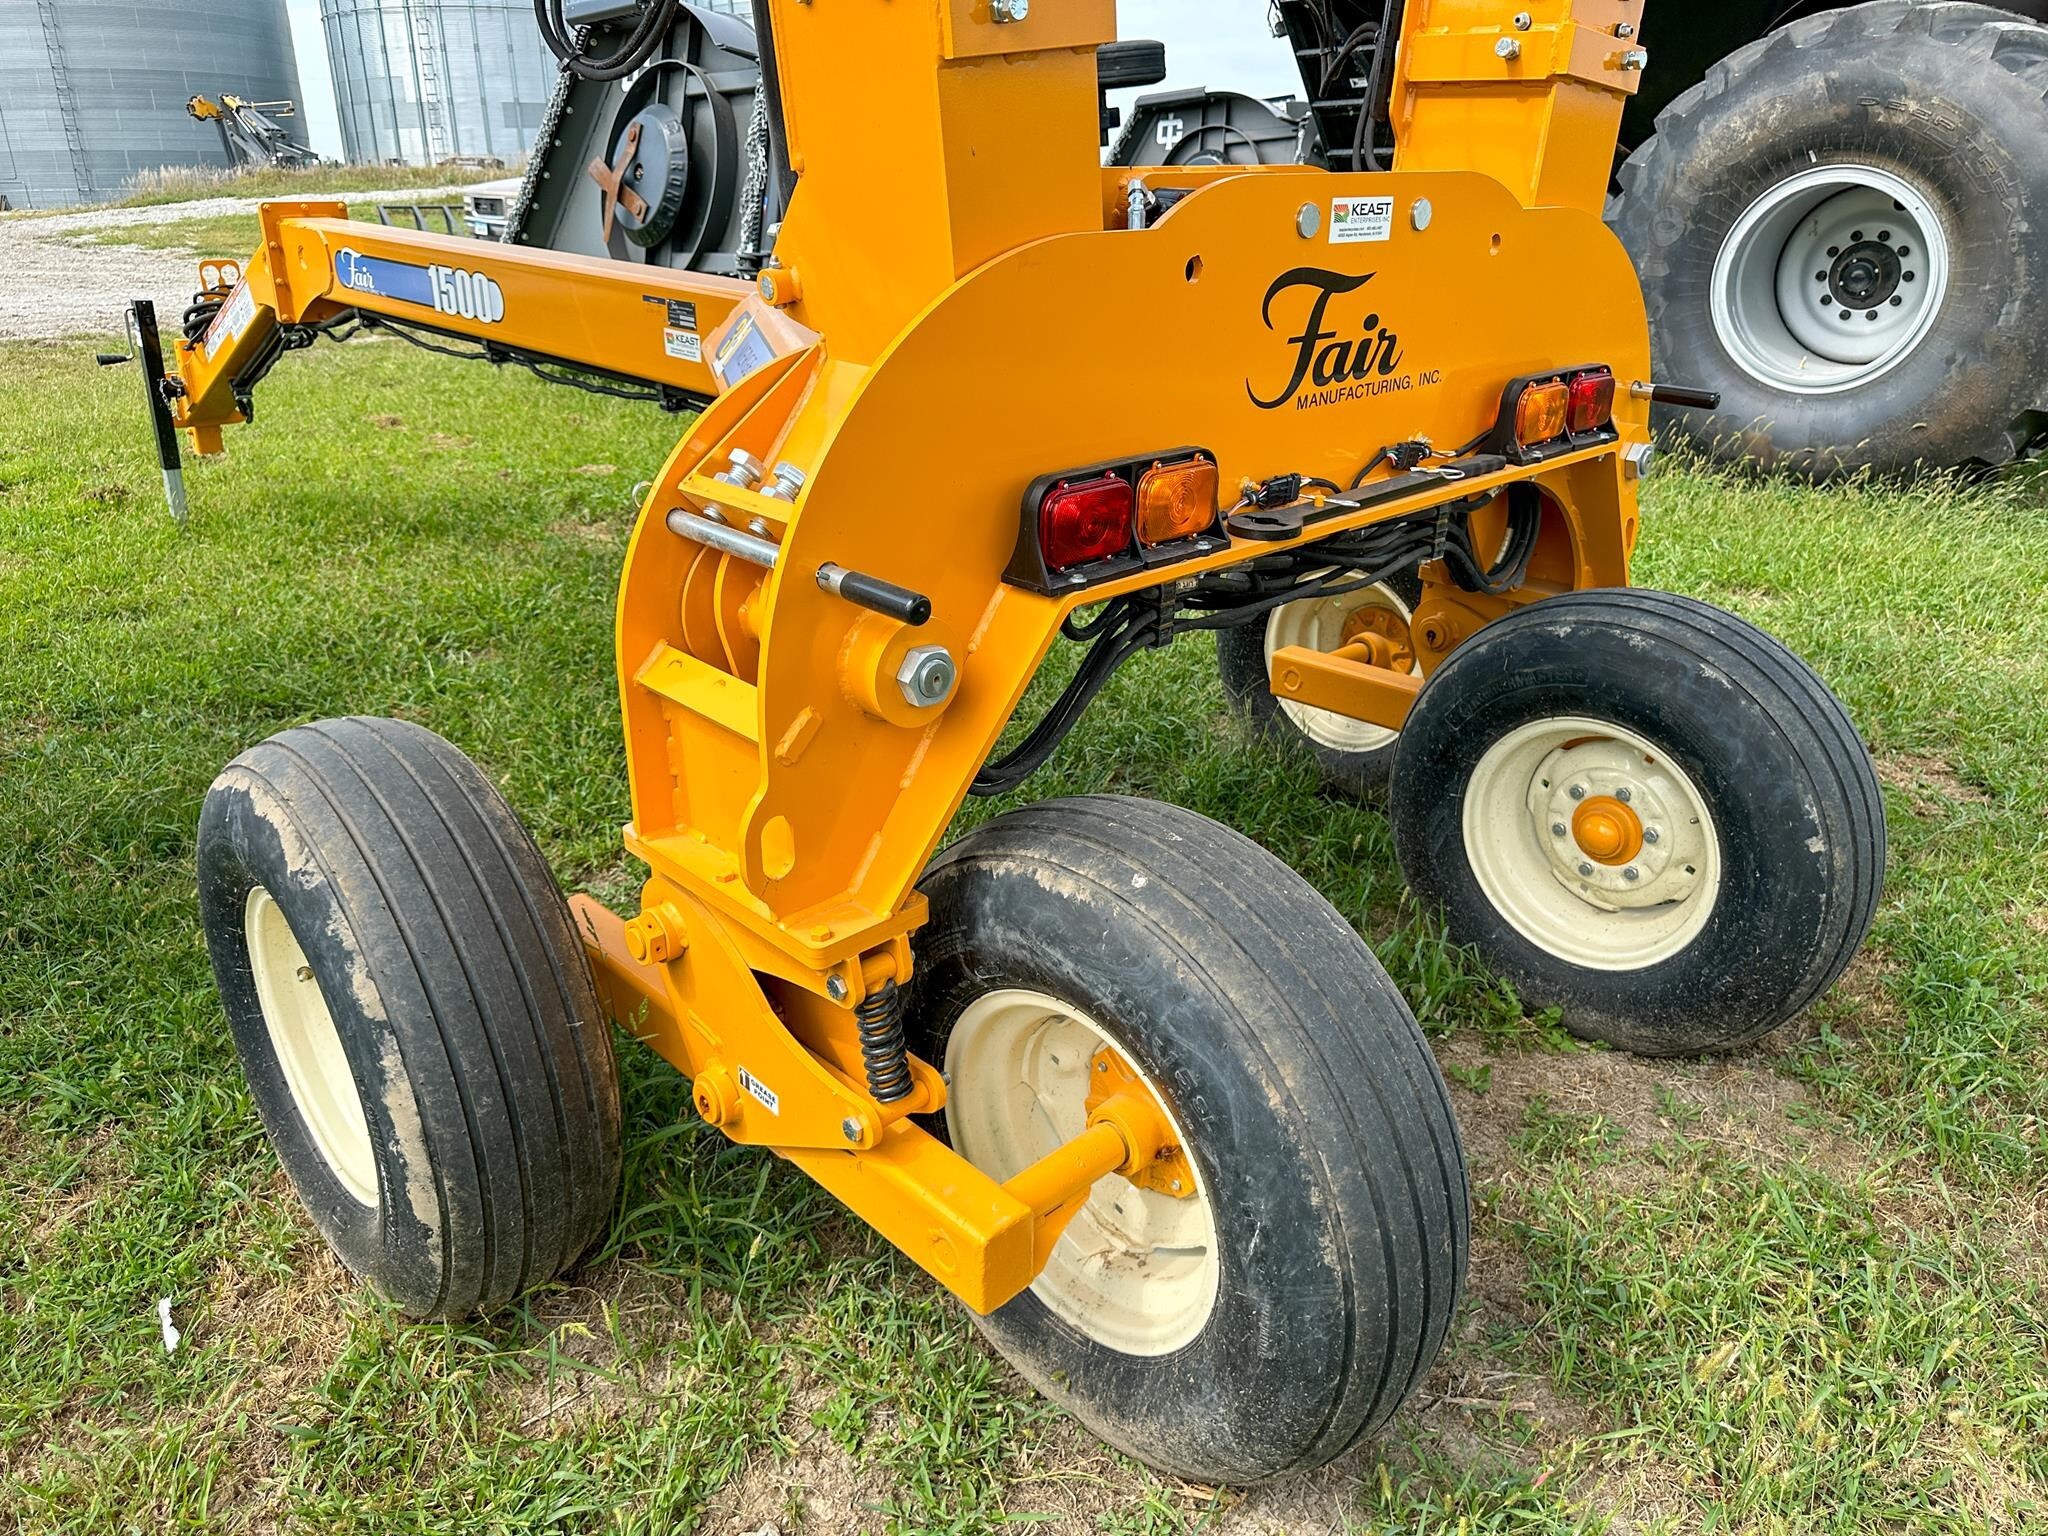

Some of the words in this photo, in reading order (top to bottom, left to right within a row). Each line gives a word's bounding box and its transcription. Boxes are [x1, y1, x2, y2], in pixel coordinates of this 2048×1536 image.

[1351, 202, 1392, 216] KEAST
[340, 246, 375, 289] Fair
[427, 263, 494, 324] 1500
[675, 334, 699, 346] KEAST
[1246, 266, 1404, 410] Fair
[1296, 375, 1414, 410] MANUFACTURING,
[1418, 369, 1443, 388] INC.
[750, 1078, 776, 1104] GREASE
[753, 1088, 774, 1108] POINT
